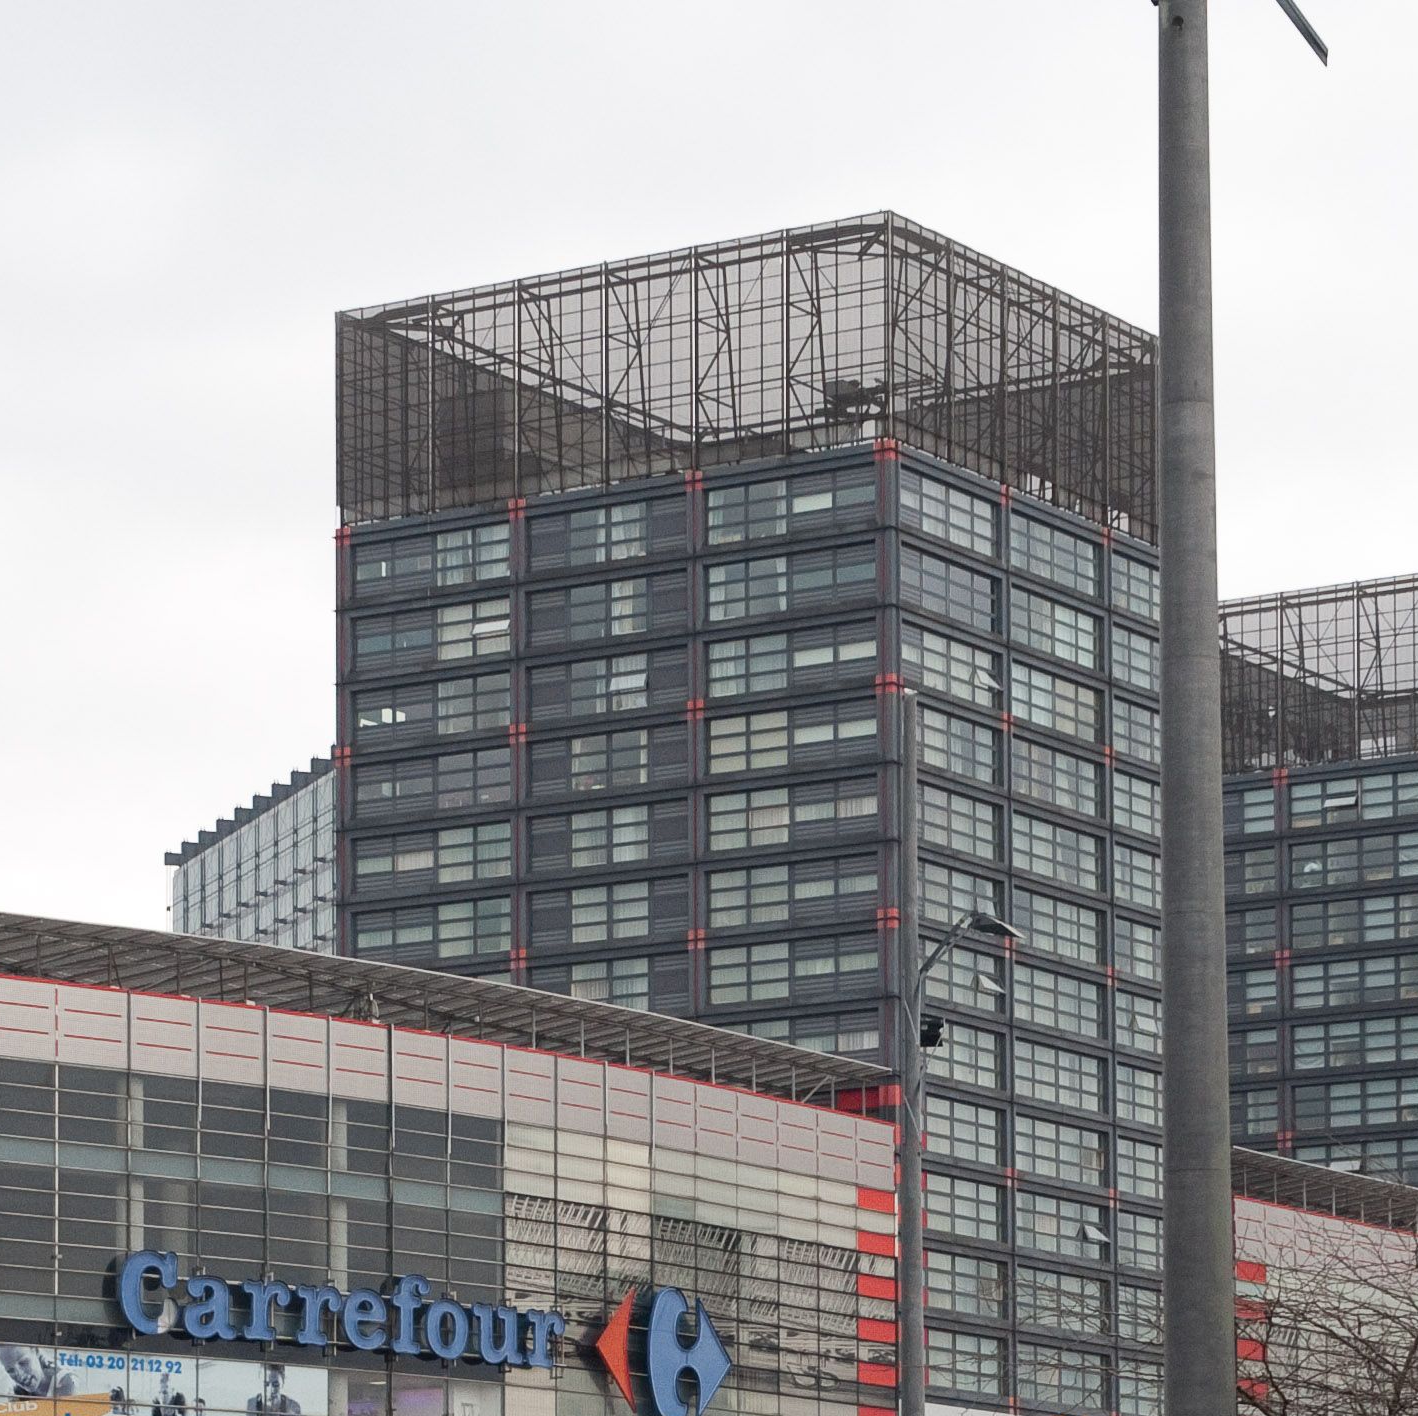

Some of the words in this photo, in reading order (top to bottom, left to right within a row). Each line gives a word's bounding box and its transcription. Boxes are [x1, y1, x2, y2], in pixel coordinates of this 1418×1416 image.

[119, 1250, 565, 1369] Carrefour
[86, 1355, 105, 1369] 03
[107, 1357, 124, 1370] 20
[132, 1358, 146, 1371] 21
[148, 1359, 163, 1373] 12
[165, 1361, 182, 1374] 92
